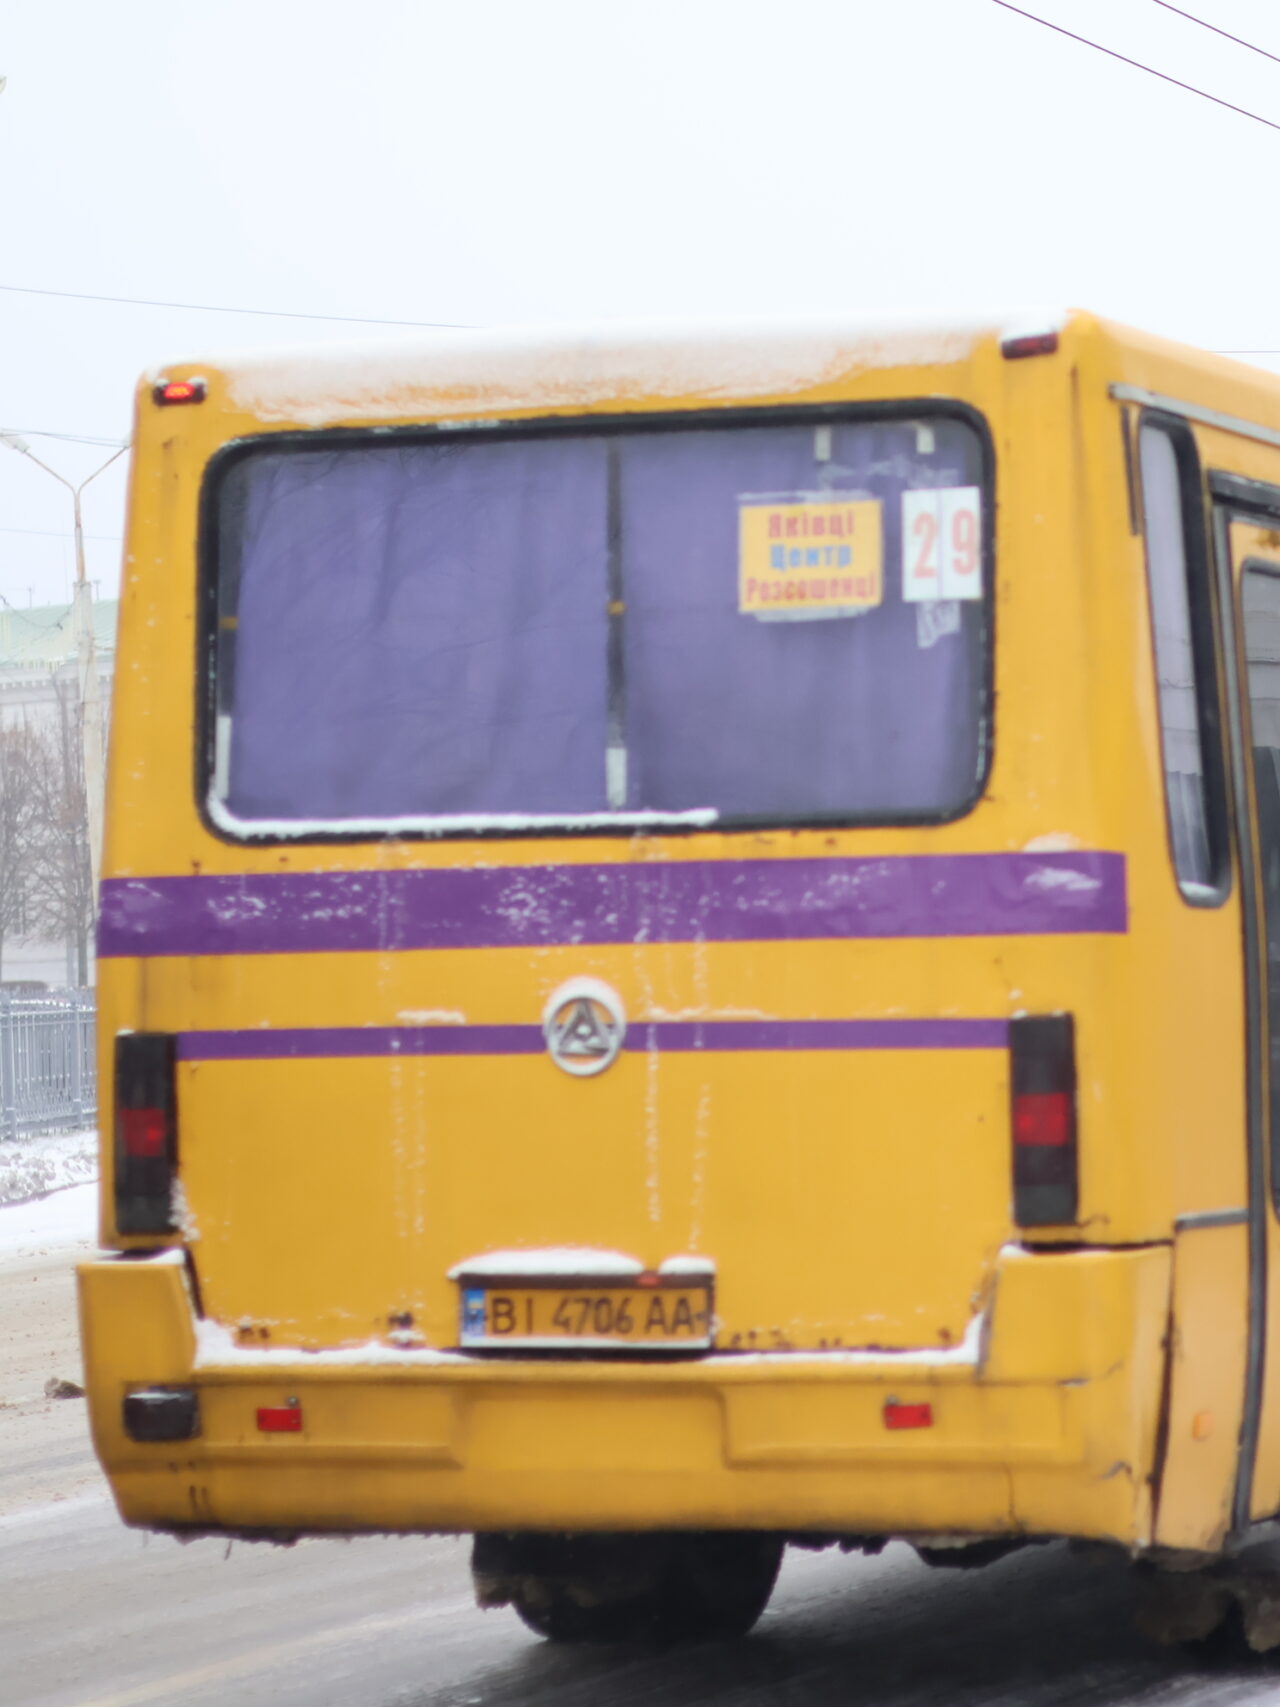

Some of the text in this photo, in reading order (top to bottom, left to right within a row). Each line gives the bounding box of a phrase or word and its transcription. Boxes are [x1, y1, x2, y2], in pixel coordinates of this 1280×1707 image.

[770, 545, 853, 572] Центр
[913, 508, 978, 578] 29
[551, 1296, 634, 1335] 4706
